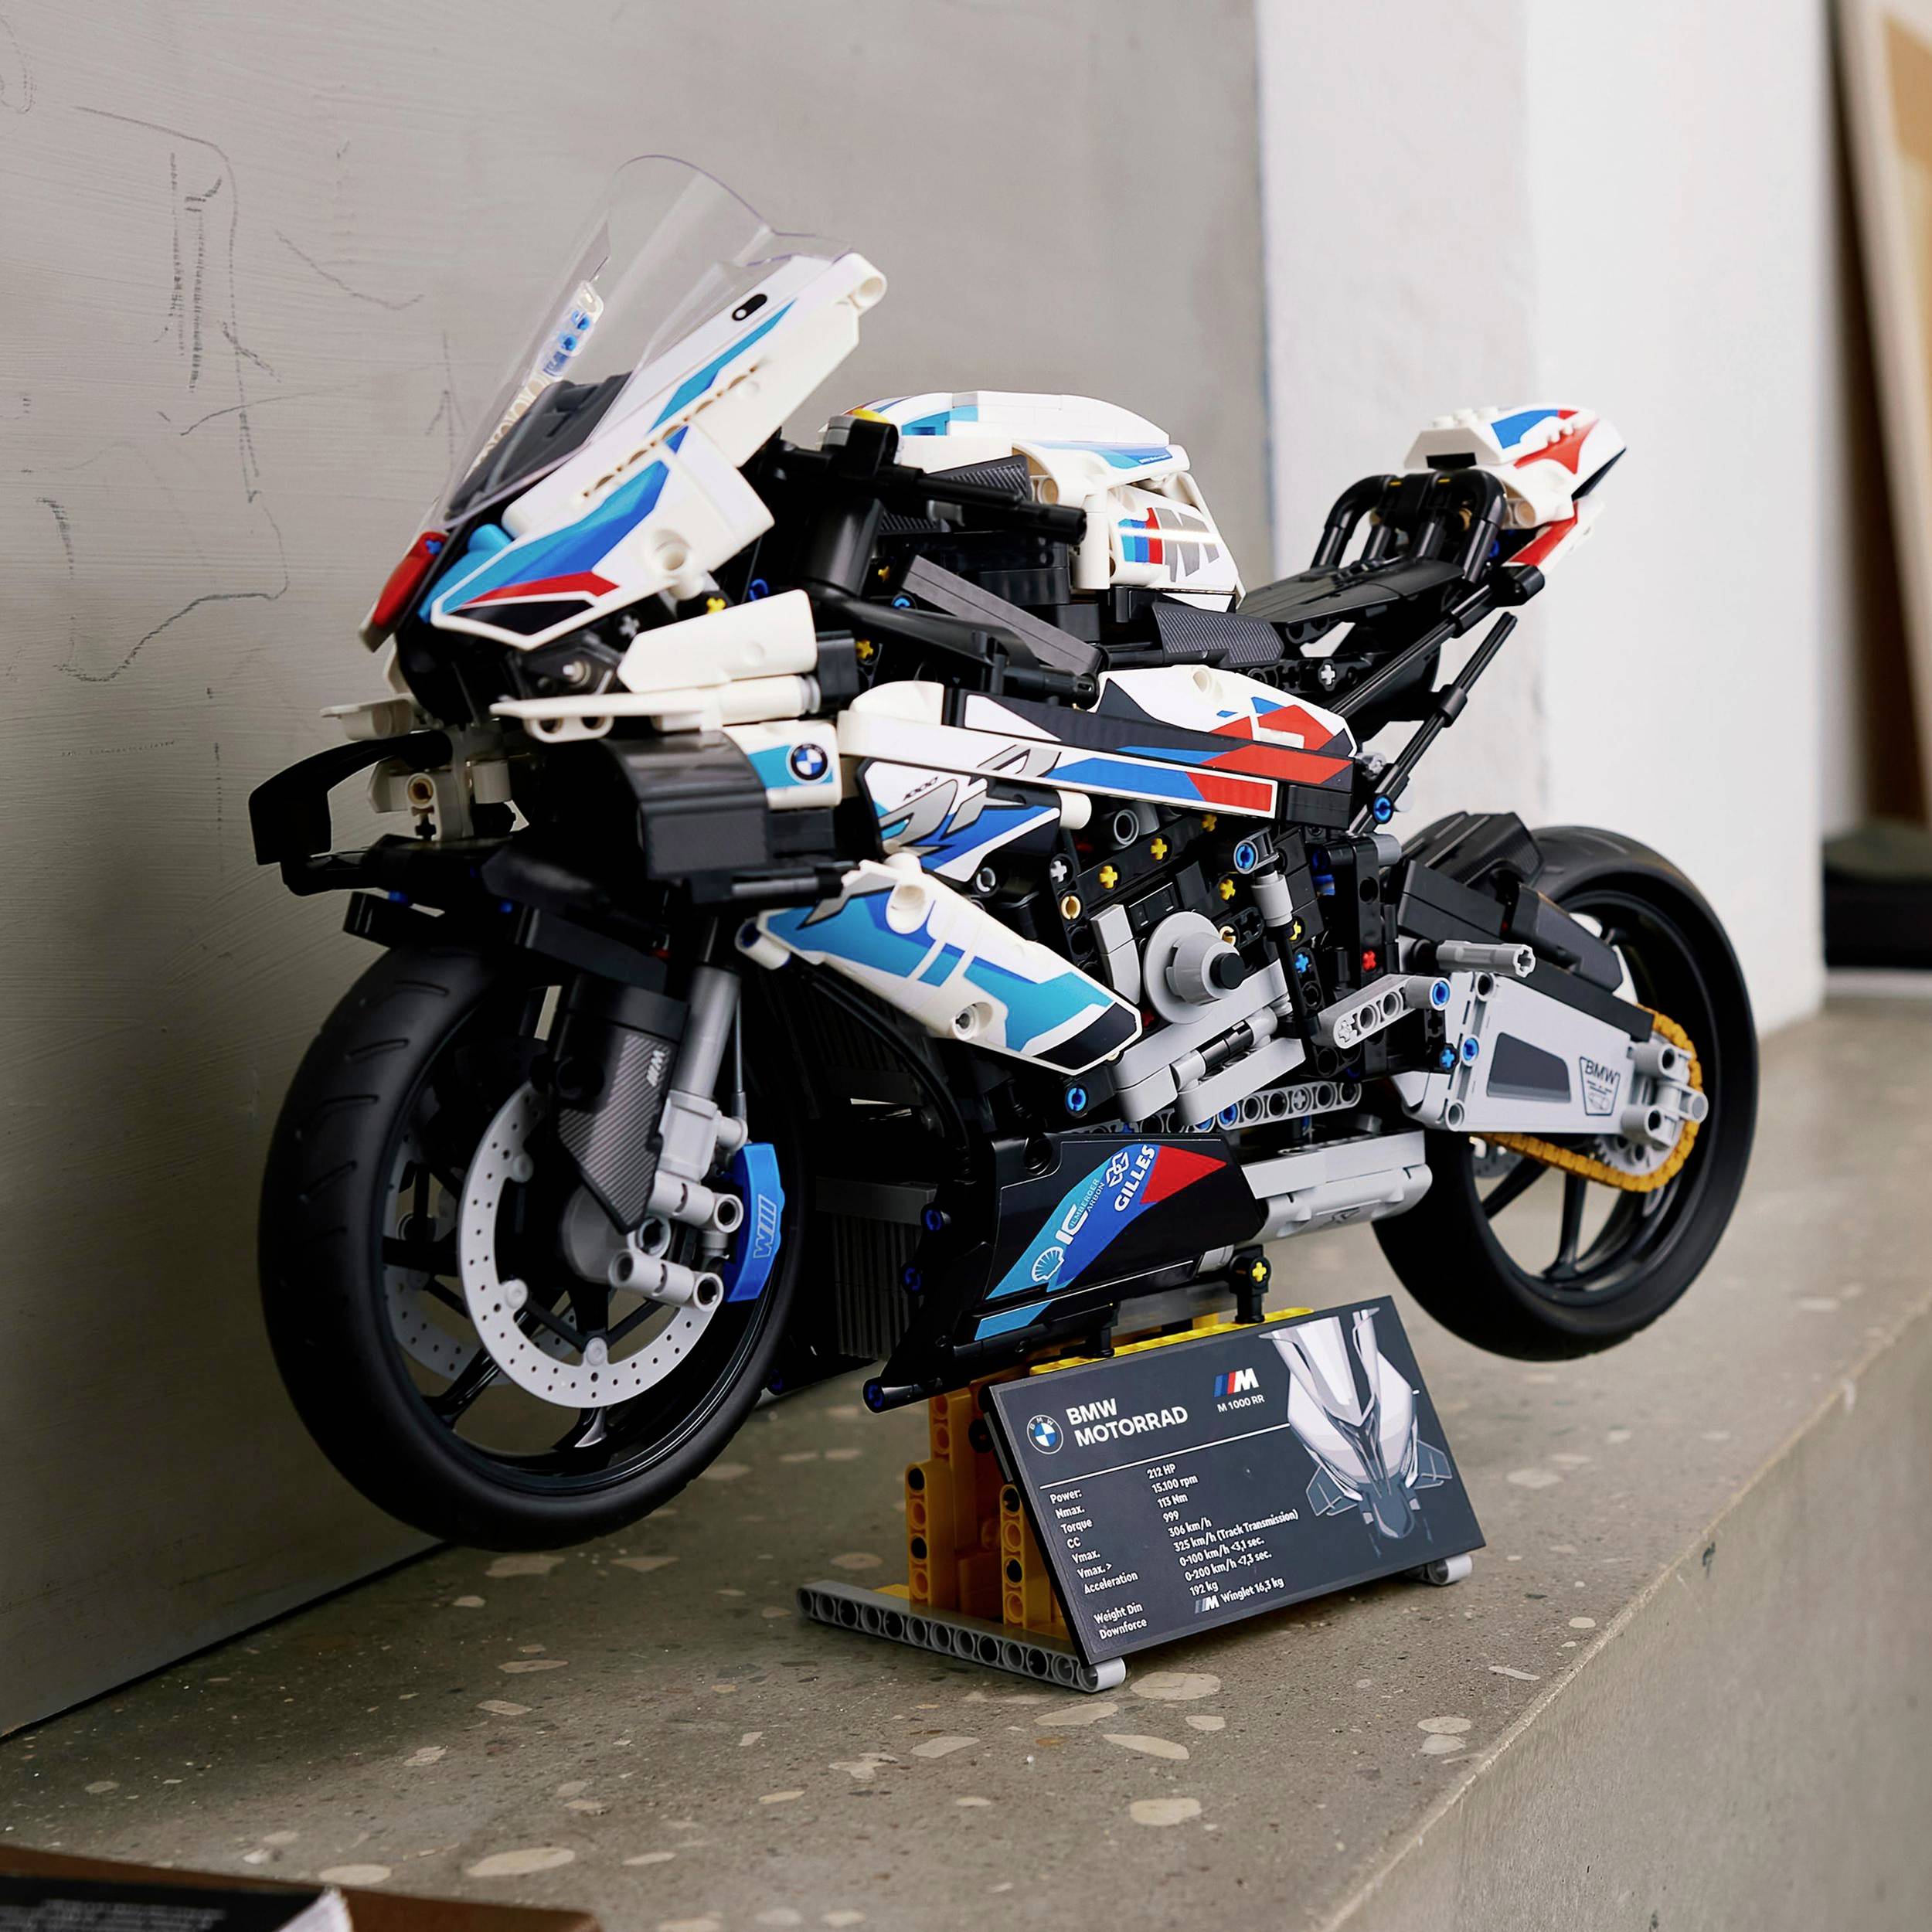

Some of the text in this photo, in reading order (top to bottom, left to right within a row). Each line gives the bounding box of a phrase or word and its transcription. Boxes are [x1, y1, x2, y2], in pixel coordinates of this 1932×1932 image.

[1585, 1060, 1616, 1084] BMW
[1114, 1145, 1155, 1212] GILLES
[1066, 1398, 1117, 1426] BMW
[1217, 1394, 1265, 1413] M 1000 RR
[1029, 1417, 1054, 1430] BMW
[1074, 1406, 1189, 1447] MOTORRAD
[1147, 1464, 1176, 1479] 212 HP
[1151, 1475, 1199, 1493] 15.100 rpm
[1049, 1489, 1083, 1504] Power:
[1158, 1494, 1188, 1509] 113 Nm
[1055, 1505, 1085, 1519] Nmax.
[1163, 1510, 1179, 1522] 999
[1060, 1519, 1093, 1534] Torque
[1168, 1517, 1213, 1537] 306 km/h
[1173, 1509, 1299, 1553] 325 km/h (Track Transmission)
[1066, 1537, 1081, 1549] CC
[1179, 1552, 1204, 1567] 0-100
[1204, 1544, 1230, 1560] km/h
[1247, 1536, 1265, 1548] sec.
[1072, 1549, 1100, 1564] Vmax.
[1185, 1566, 1210, 1582] 0-200
[1211, 1558, 1236, 1575] km/h
[1254, 1549, 1272, 1562] sec.
[1077, 1565, 1106, 1579] Vmax.
[1083, 1571, 1138, 1594] Acceleration
[1189, 1581, 1219, 1597] 192 kg
[1220, 1587, 1255, 1604] Winglet
[1254, 1580, 1272, 1594] 16,3
[1271, 1577, 1285, 1589] kg
[1094, 1602, 1143, 1624] Weight Din
[1099, 1618, 1148, 1640] Downforce
